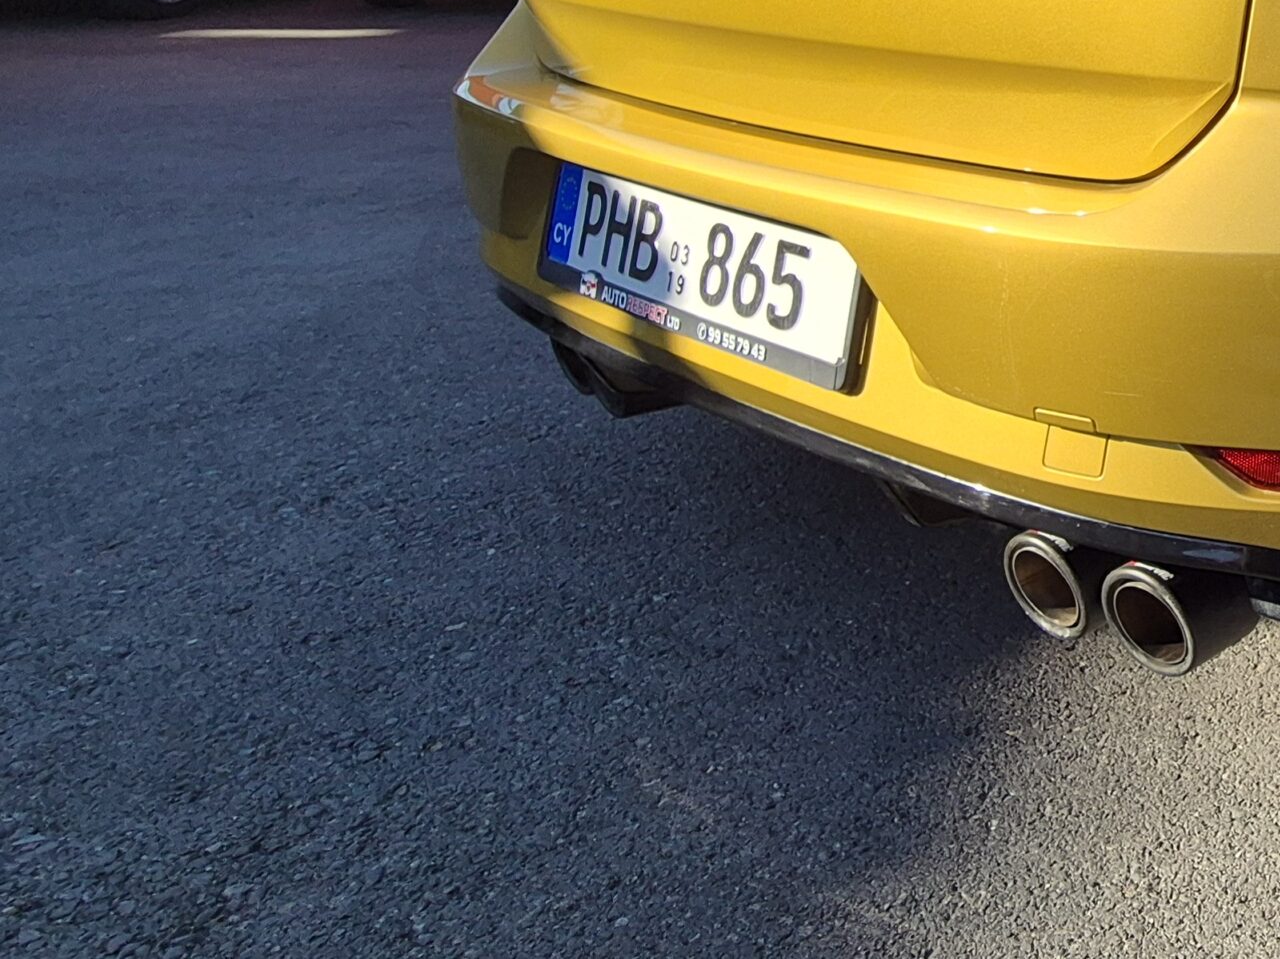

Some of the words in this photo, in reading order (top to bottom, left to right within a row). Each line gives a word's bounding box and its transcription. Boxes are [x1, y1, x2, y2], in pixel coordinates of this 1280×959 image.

[553, 222, 573, 247] CY
[578, 180, 663, 282] PHB
[699, 222, 812, 330] 865
[670, 241, 690, 266] 03
[667, 271, 685, 295] 19
[707, 326, 722, 345] 99
[721, 333, 736, 352] 55
[736, 337, 751, 356] 79
[750, 343, 766, 361] 43
